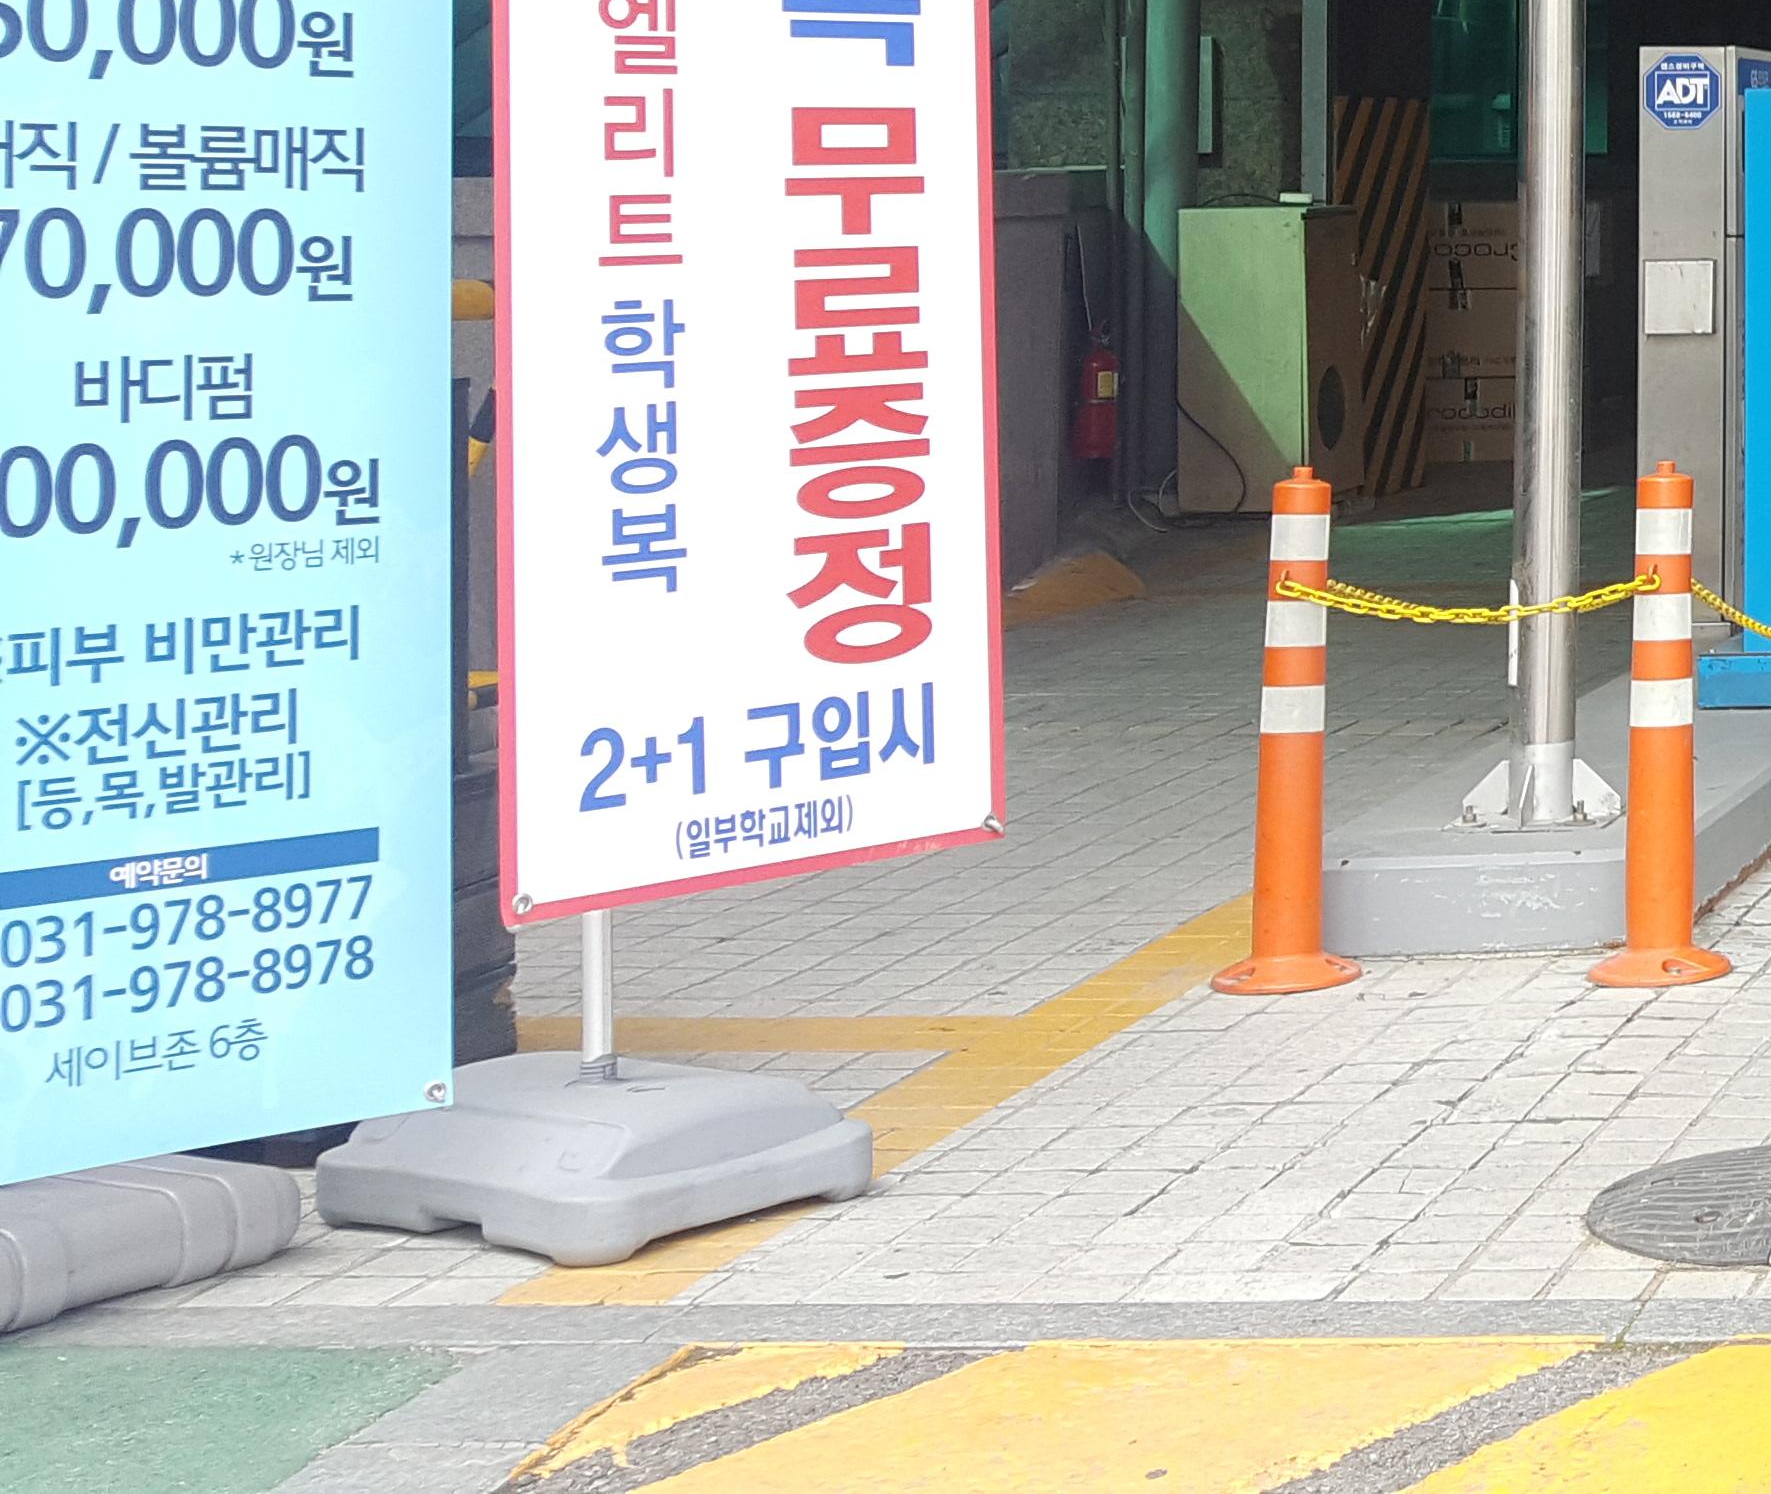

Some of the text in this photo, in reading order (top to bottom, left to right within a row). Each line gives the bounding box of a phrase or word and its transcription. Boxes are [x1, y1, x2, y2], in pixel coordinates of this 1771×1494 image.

[1657, 77, 1709, 105] ADT
[129, 123, 365, 193] 볼륨매직
[74, 353, 254, 423] 바디펌
[784, 107, 933, 664] 무료증정
[596, 299, 688, 593] 학생복
[331, 535, 380, 566] 제외
[0, 604, 360, 686] 피부 비만관리
[578, 680, 937, 812] 2+1 구입시
[17, 750, 311, 832] [등,목,발관리]
[676, 793, 855, 861] (일부학교제외)
[108, 852, 209, 890] 예약문의
[0, 874, 373, 968] 031-978-8977
[0, 935, 375, 1033] 031-978-8978
[45, 1017, 269, 1088] 세이브존 6층
